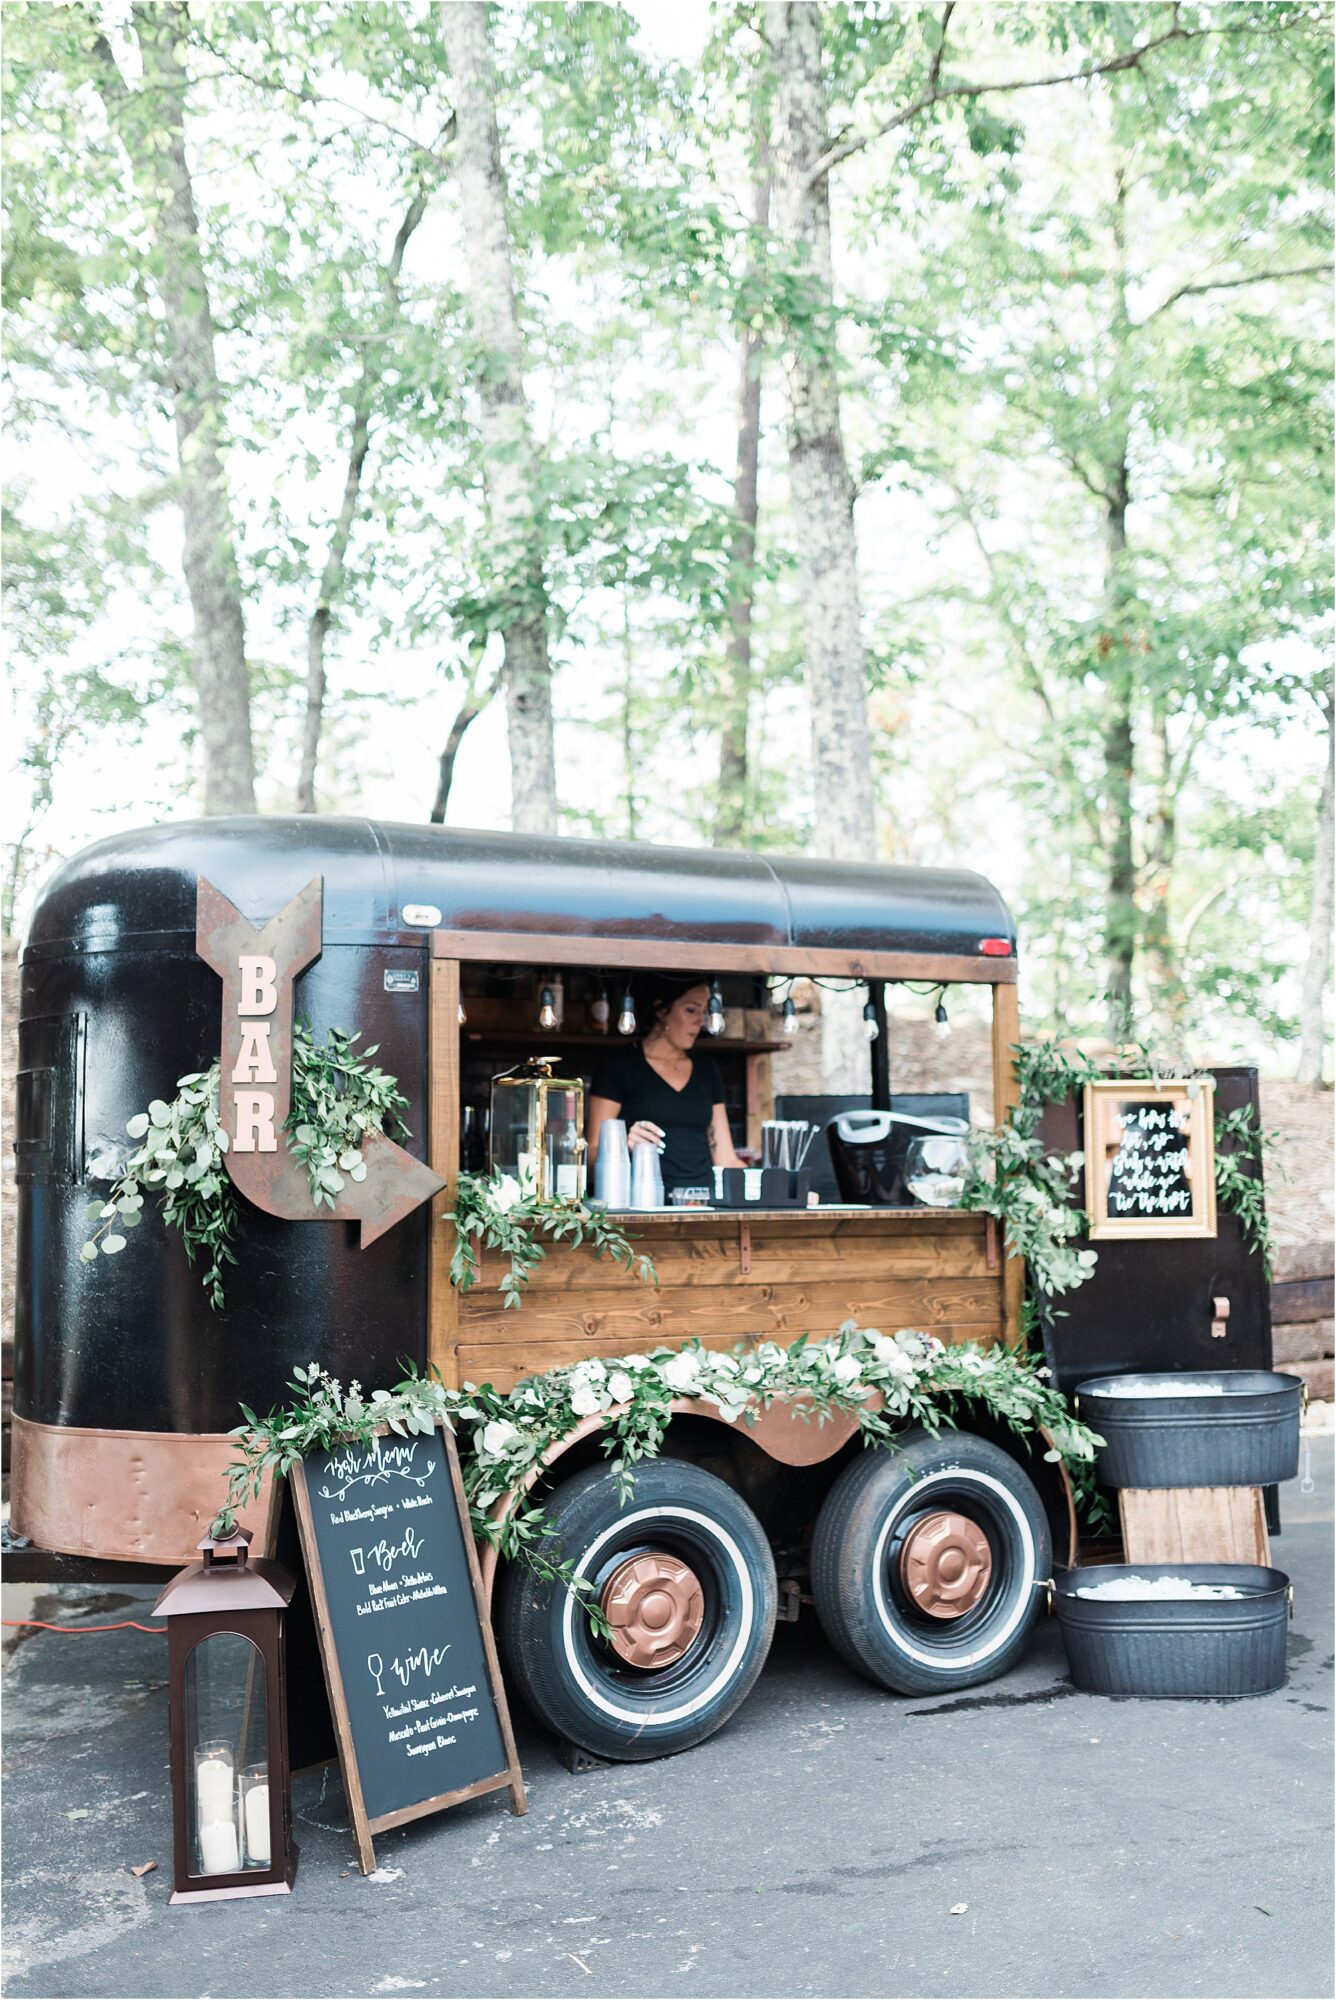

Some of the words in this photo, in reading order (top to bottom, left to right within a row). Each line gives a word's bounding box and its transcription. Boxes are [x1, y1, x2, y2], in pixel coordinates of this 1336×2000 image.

[232, 955, 278, 1153] BAR
[1155, 1173, 1181, 1190] we
[367, 1527, 425, 1572] Beer
[368, 1583, 383, 1596] Blue
[356, 1601, 372, 1616] Bold
[389, 1724, 414, 1743] Moscato
[436, 1735, 457, 1748] Blanc
